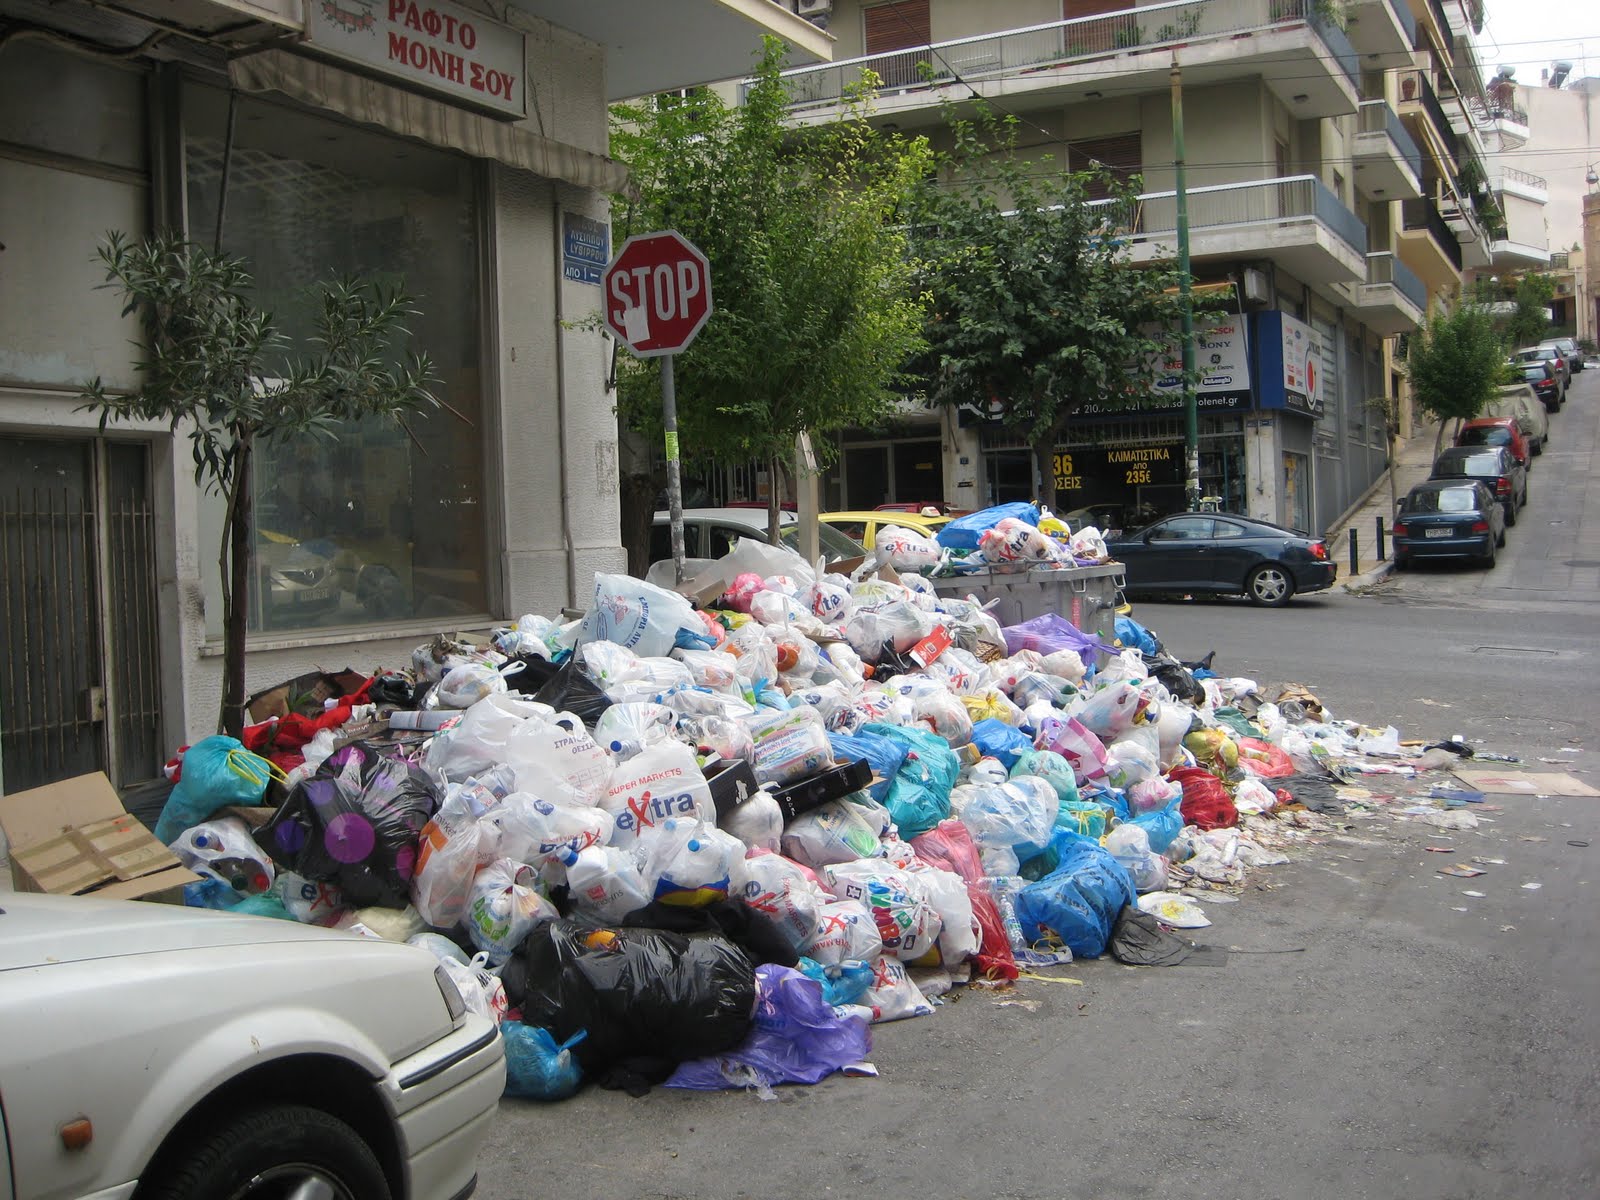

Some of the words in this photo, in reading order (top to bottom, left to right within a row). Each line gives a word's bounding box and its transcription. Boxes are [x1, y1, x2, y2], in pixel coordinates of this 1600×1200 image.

[387, 31, 465, 85] ΜΟΝΗ
[469, 64, 516, 102] ΣΟΥ
[565, 266, 581, 278] ΑΠΟ
[611, 260, 700, 328] STOP
[1199, 341, 1232, 350] SONY
[1053, 454, 1073, 476] 36
[1107, 448, 1170, 463] ΚΛΙΜΑΤΙΣΤΙΚΑ
[1132, 462, 1148, 470] ΑΠΟ
[1126, 470, 1152, 485] 235€
[608, 780, 638, 797] SUPER
[638, 767, 682, 785] MARKETS
[616, 791, 695, 838] eXtra
[785, 899, 809, 938] MARKETS
